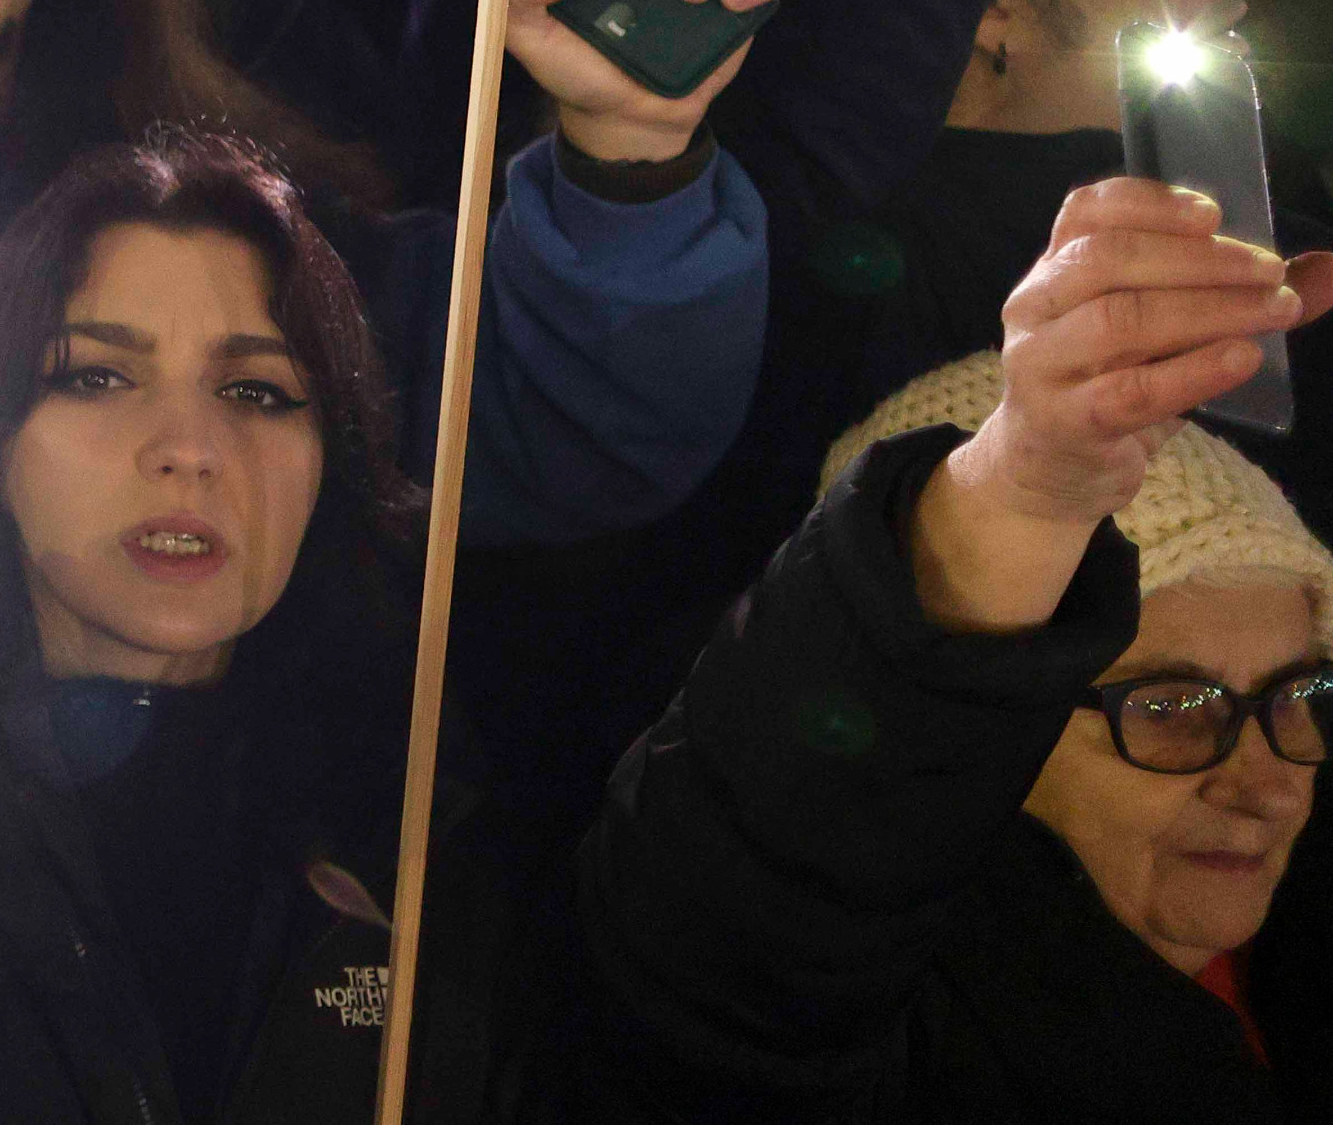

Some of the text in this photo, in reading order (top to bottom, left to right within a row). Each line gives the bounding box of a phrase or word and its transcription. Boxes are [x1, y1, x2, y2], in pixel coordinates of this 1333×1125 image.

[344, 966, 378, 987] THE
[315, 987, 383, 1008] NORTH
[341, 1006, 384, 1027] FACE
